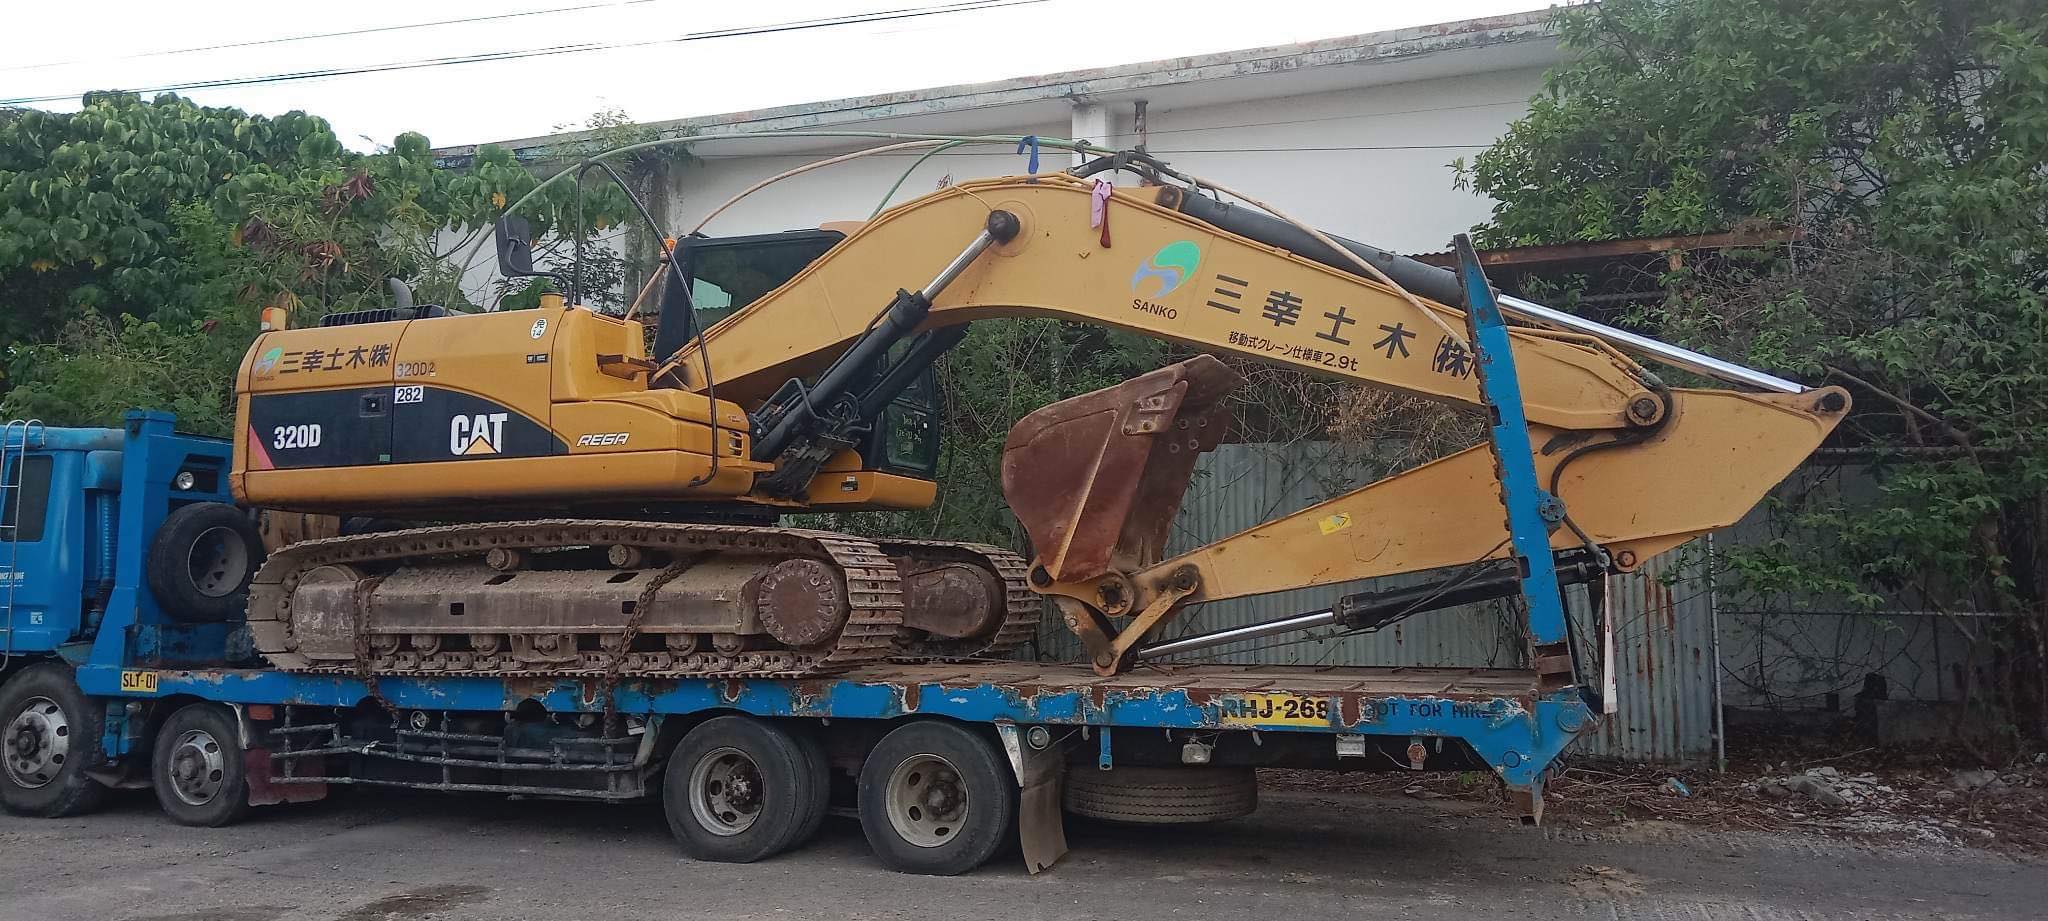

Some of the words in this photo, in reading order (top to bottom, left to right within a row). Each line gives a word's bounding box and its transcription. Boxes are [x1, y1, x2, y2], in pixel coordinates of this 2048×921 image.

[1132, 299, 1177, 320] SANKO
[398, 388, 421, 401] 282
[274, 424, 321, 450] 320D
[450, 413, 507, 455] CAT
[577, 433, 629, 447] REGA
[123, 673, 156, 689] SLT-01
[1221, 699, 1329, 719] RHJ-268
[1362, 702, 1399, 717] OT
[1410, 703, 1442, 717] FOR
